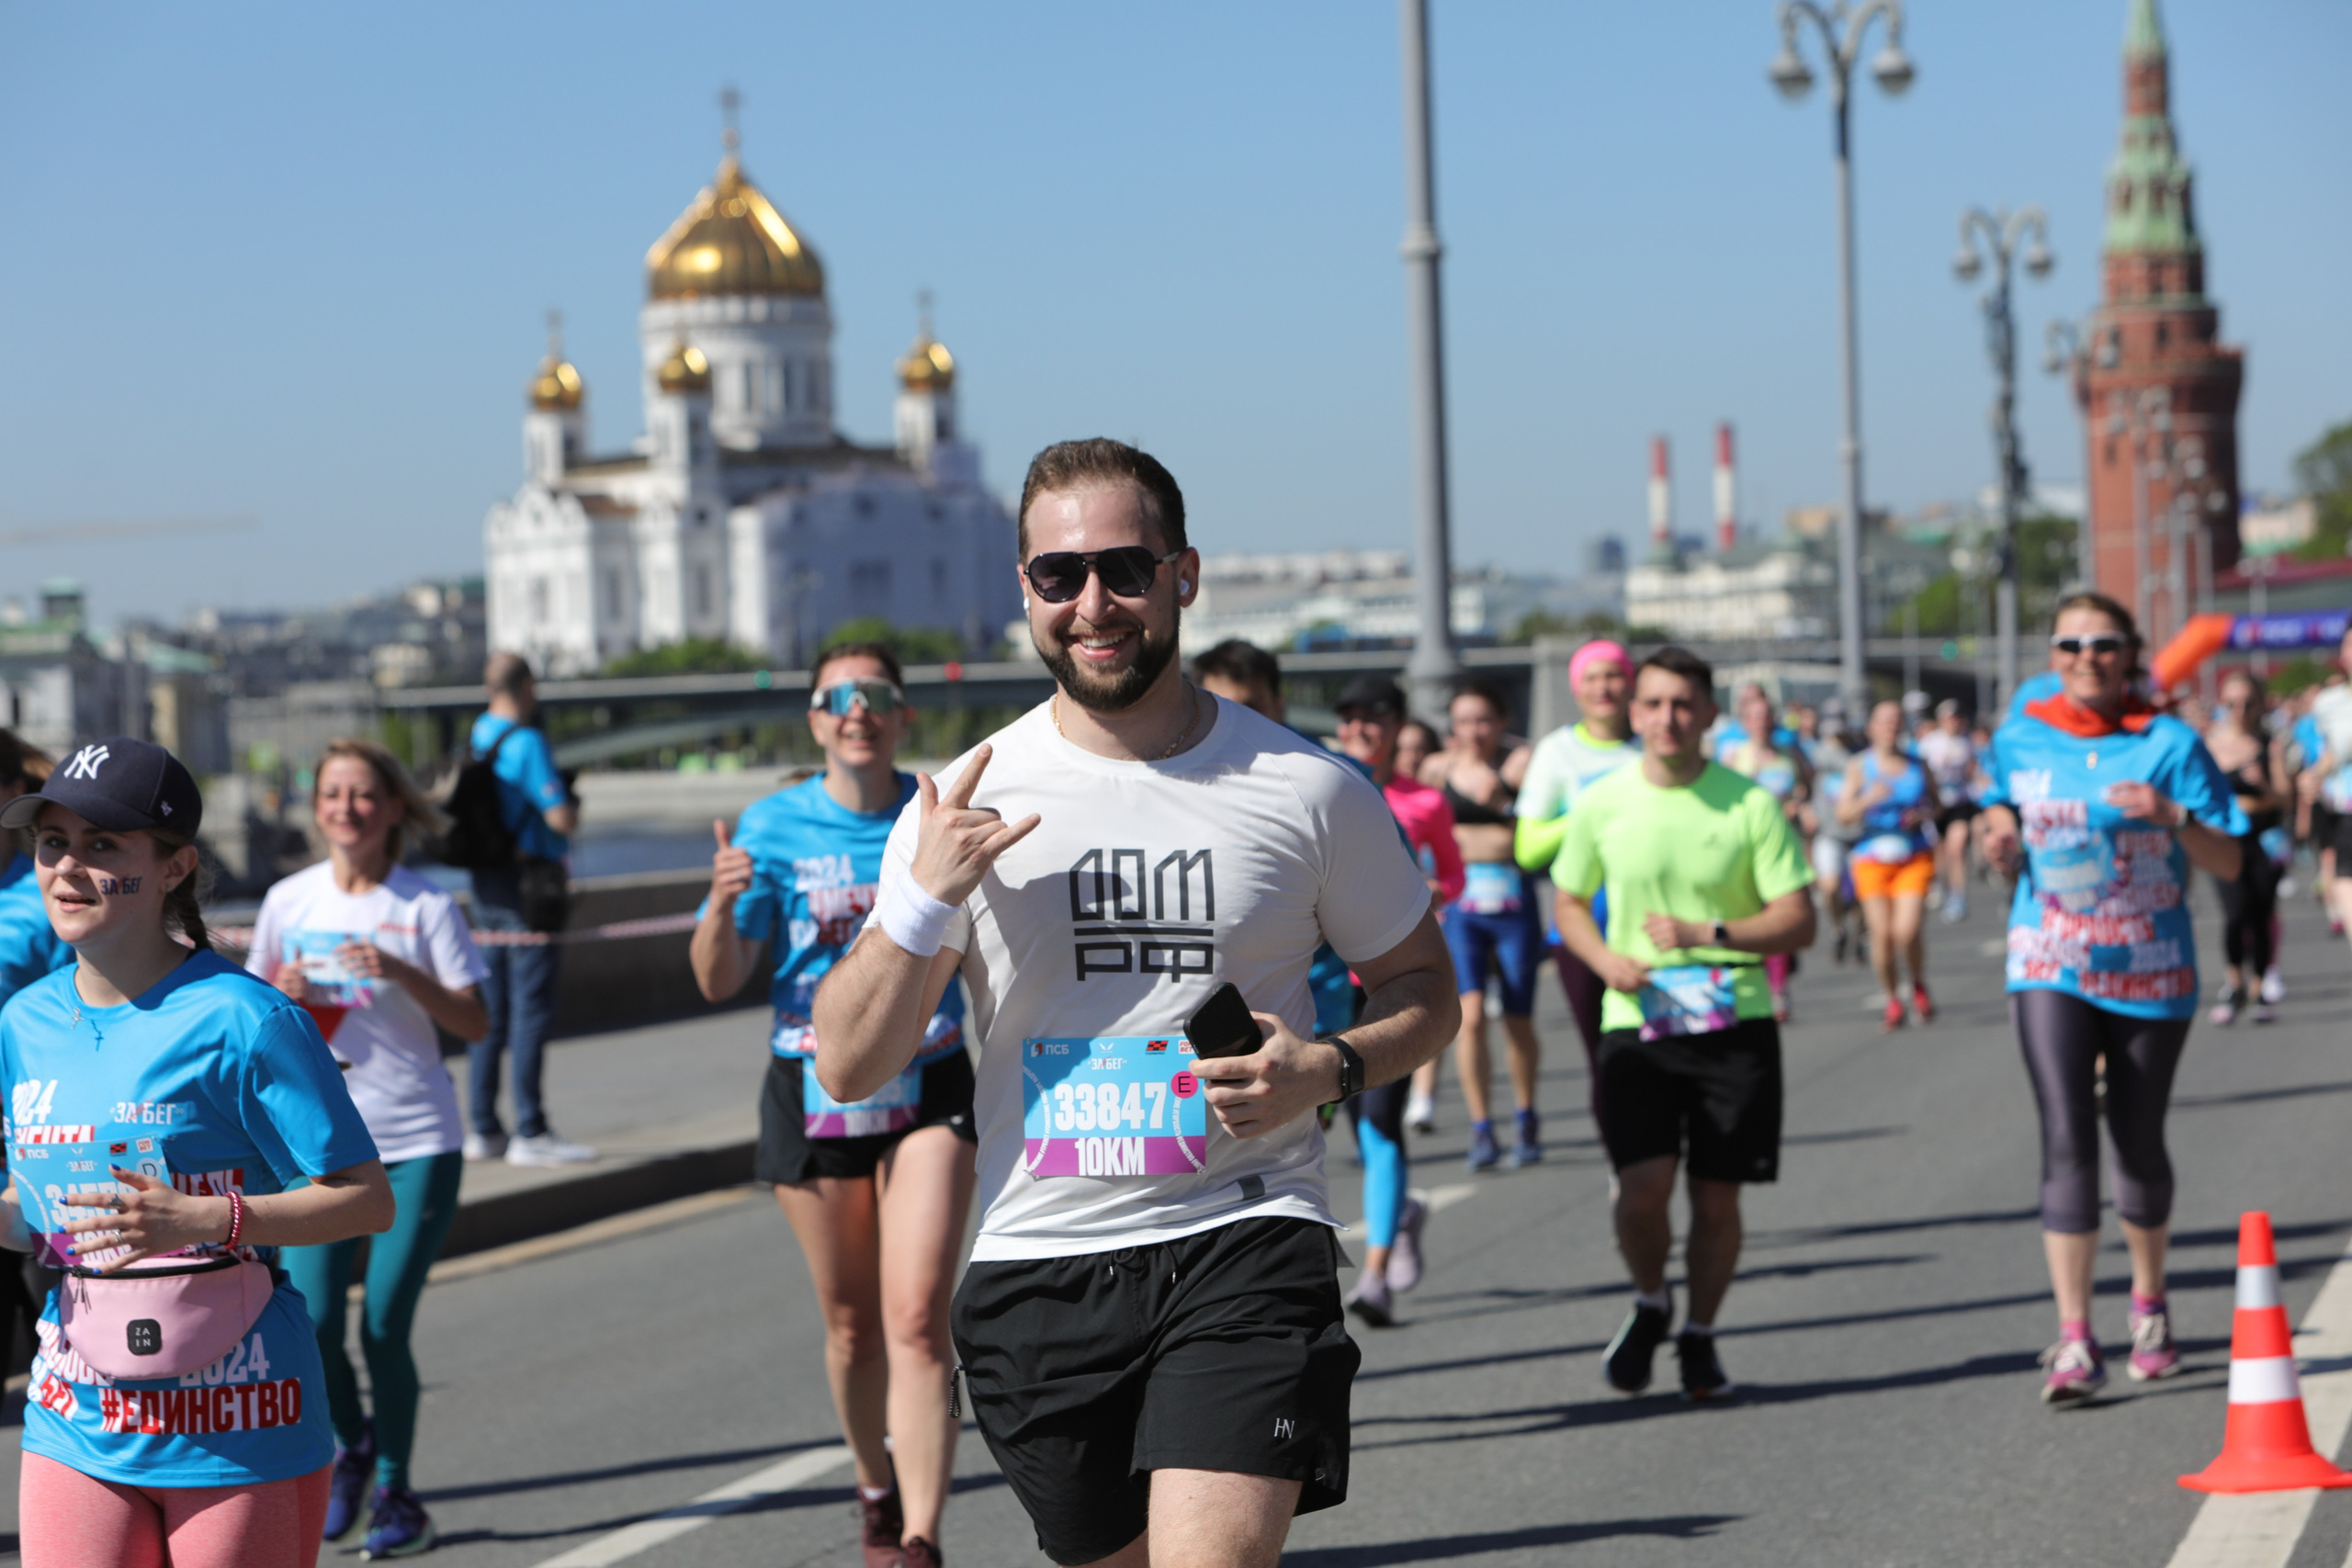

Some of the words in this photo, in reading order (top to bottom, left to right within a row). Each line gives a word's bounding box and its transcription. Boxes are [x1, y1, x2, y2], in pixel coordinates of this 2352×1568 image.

[1075, 941, 1215, 984] РФ
[1045, 1043, 1070, 1055] ПСБ
[1054, 1082, 1167, 1132] 33847
[135, 1326, 151, 1337] ZA
[135, 1337, 152, 1348] IN
[101, 1378, 301, 1435] #ЕДИНСТВО
